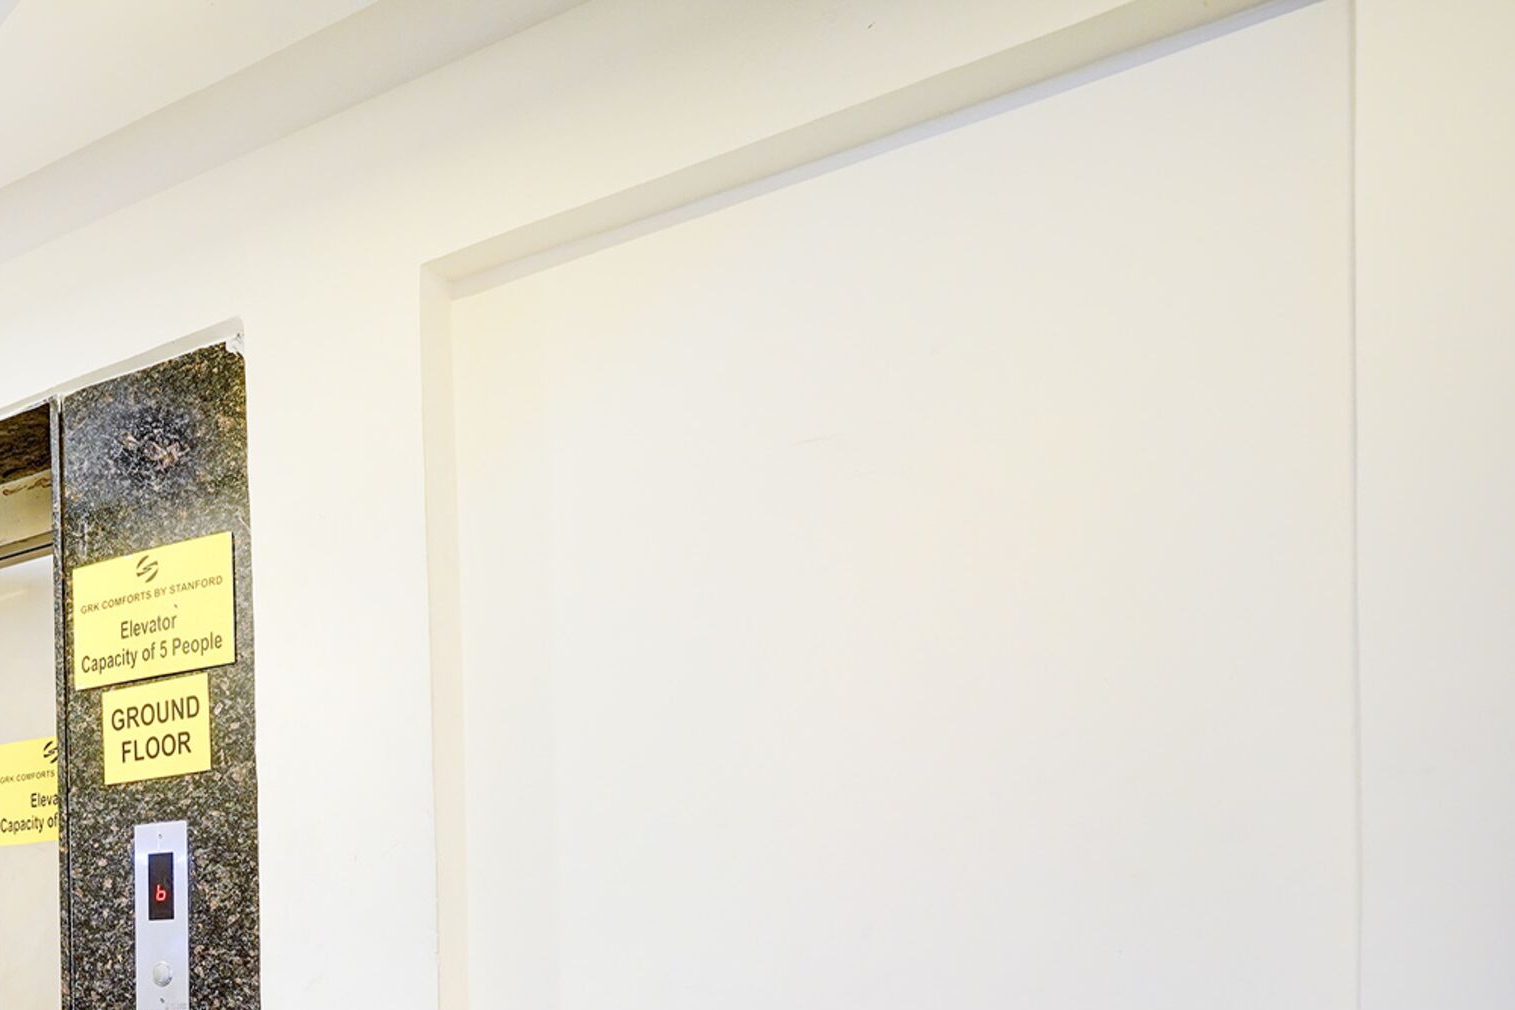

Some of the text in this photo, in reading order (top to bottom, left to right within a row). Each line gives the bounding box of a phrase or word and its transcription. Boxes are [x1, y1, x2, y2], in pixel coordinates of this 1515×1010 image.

[80, 575, 223, 614] GRK COMFORTS BY STANFORD
[121, 615, 177, 639] Elevator
[81, 632, 223, 674] Capacity of 5 People
[111, 694, 200, 732] GROUND
[121, 731, 192, 764] FLOOR
[16, 770, 55, 782] COMFORTS
[0, 812, 59, 834] Capacity of
